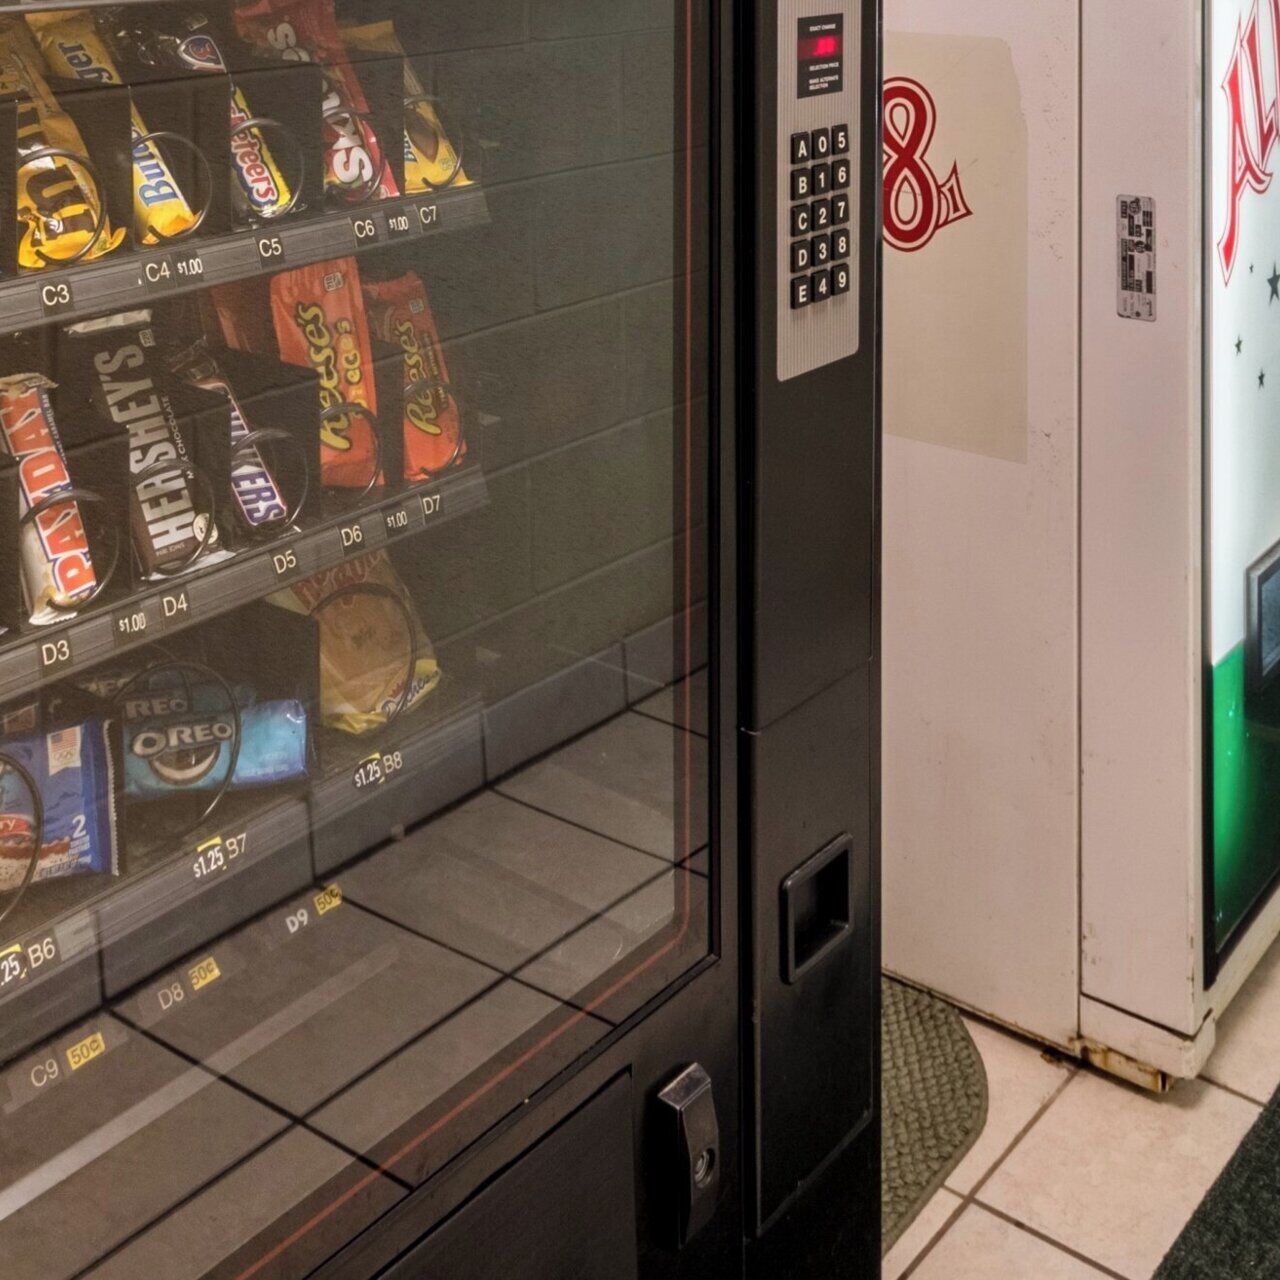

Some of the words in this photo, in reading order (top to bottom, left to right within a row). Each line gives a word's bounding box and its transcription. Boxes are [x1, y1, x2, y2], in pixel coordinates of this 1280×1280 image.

[798, 140, 807, 157] A
[819, 136, 827, 152] 0
[838, 132, 846, 148] 5
[819, 172, 825, 188] 1
[838, 167, 846, 183] 6
[799, 177, 807, 193] B
[420, 206, 437, 224] C7
[819, 208, 827, 224] 2
[838, 202, 846, 218] 7
[354, 220, 375, 238] C6
[389, 216, 408, 231] $1.00
[798, 213, 807, 230] C
[259, 238, 282, 257] C5
[819, 243, 826, 259] 3
[838, 236, 846, 253] 8
[799, 249, 807, 266] D
[145, 261, 170, 282] C4
[177, 258, 203, 276] $1.00
[838, 271, 846, 288] 9
[42, 284, 70, 306] C3
[799, 285, 807, 302] E
[819, 277, 827, 294] 4
[41, 393, 50, 408] BAR
[161, 395, 187, 455] CHOCOLATE
[94, 344, 197, 551] HERSHEY'S
[422, 495, 441, 514] D7
[341, 525, 363, 546] D6
[387, 511, 408, 528] $1.00
[273, 550, 297, 574] D5
[162, 593, 188, 617] D4
[41, 640, 70, 666] D3
[119, 612, 146, 634] $1.00
[133, 722, 233, 756] OREO
[354, 759, 382, 788] $1.25
[382, 751, 403, 774] B8
[72, 814, 87, 839] 2
[192, 847, 224, 878] $1.25
[225, 833, 247, 859] B7
[285, 908, 309, 934] D9
[316, 887, 339, 911] 50¢
[28, 937, 56, 969] B6
[158, 983, 185, 1010] D8
[191, 960, 217, 986] 50¢
[31, 1058, 59, 1087] C9
[71, 1038, 101, 1066] 50¢
